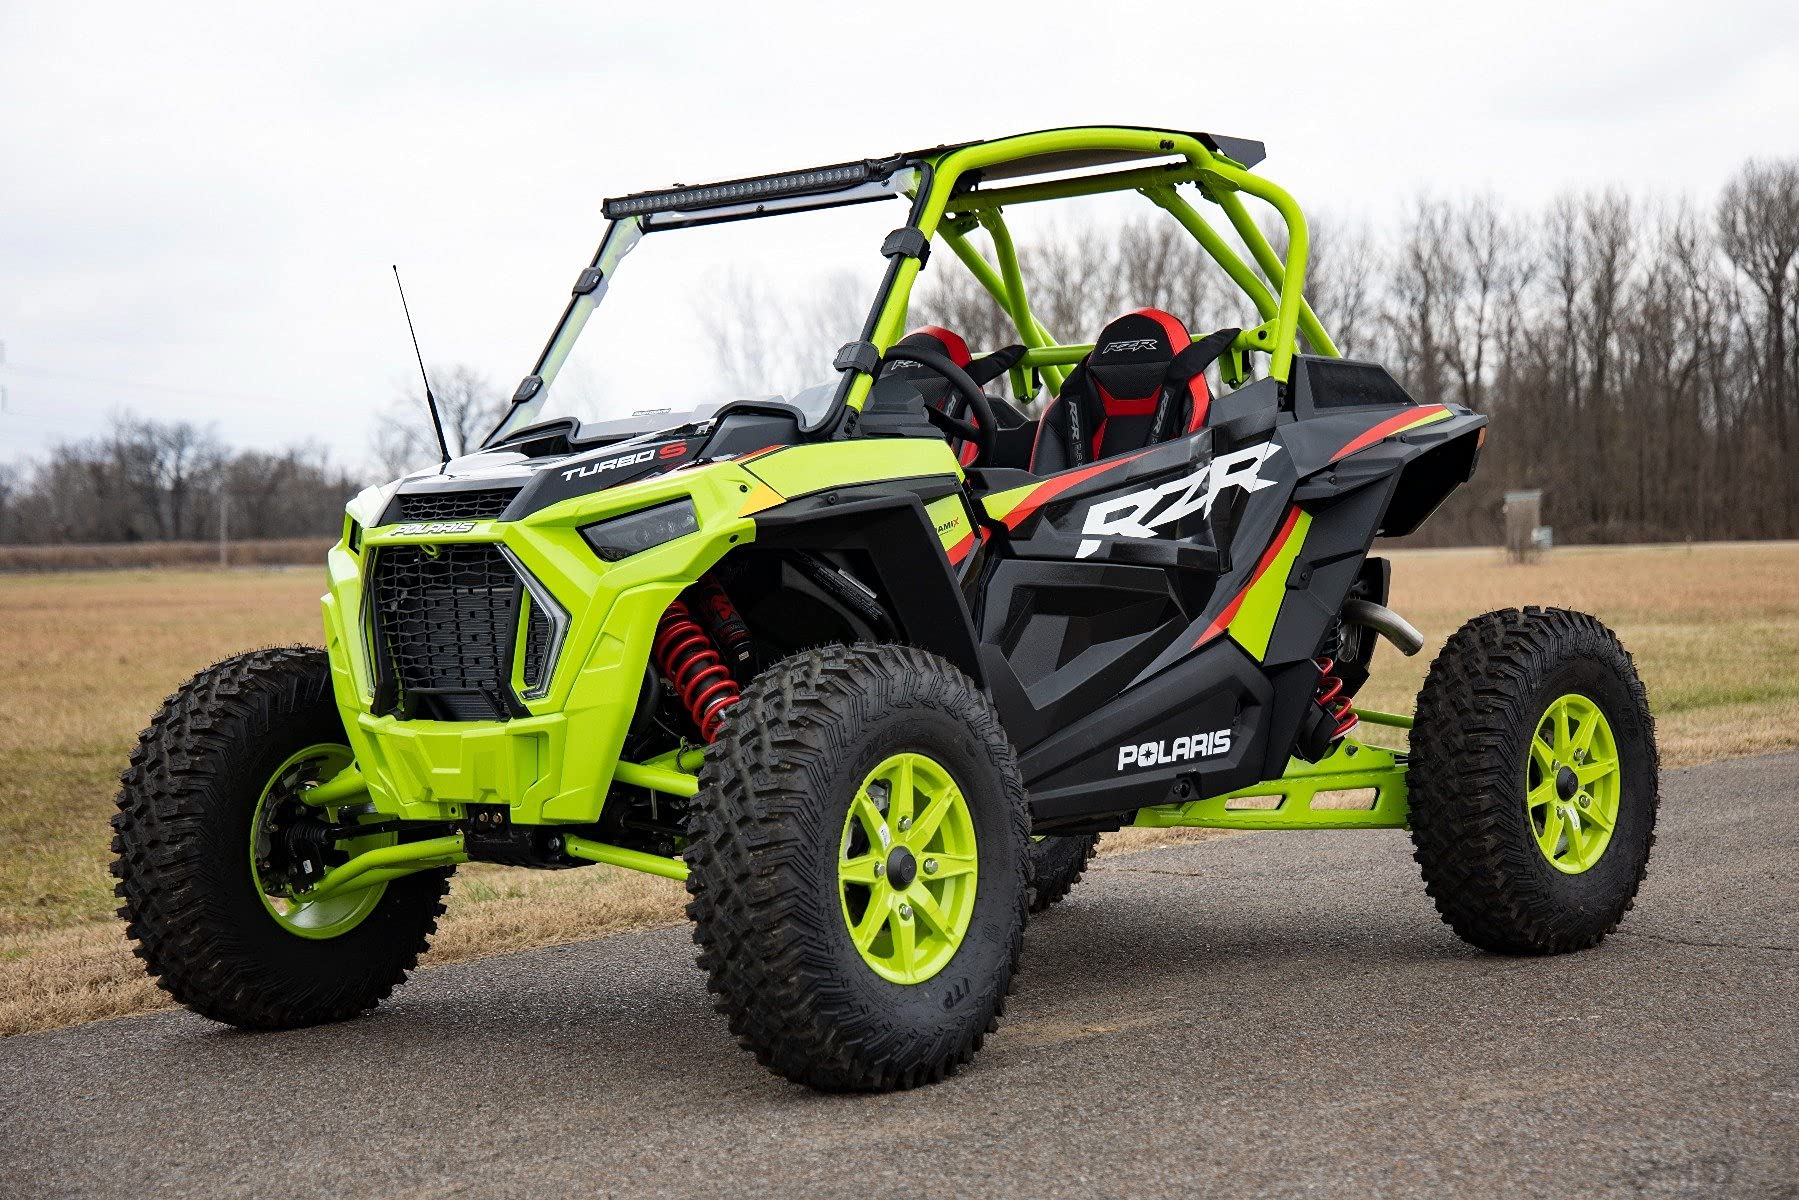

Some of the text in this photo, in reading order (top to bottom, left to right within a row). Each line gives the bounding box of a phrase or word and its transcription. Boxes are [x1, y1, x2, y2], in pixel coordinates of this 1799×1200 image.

[1101, 338, 1158, 355] RZR
[890, 359, 924, 371] RZ
[560, 441, 688, 482] TURBO S
[1074, 441, 1283, 559] RZR
[390, 521, 479, 537] POLARIS
[1117, 728, 1232, 771] POLARIS
